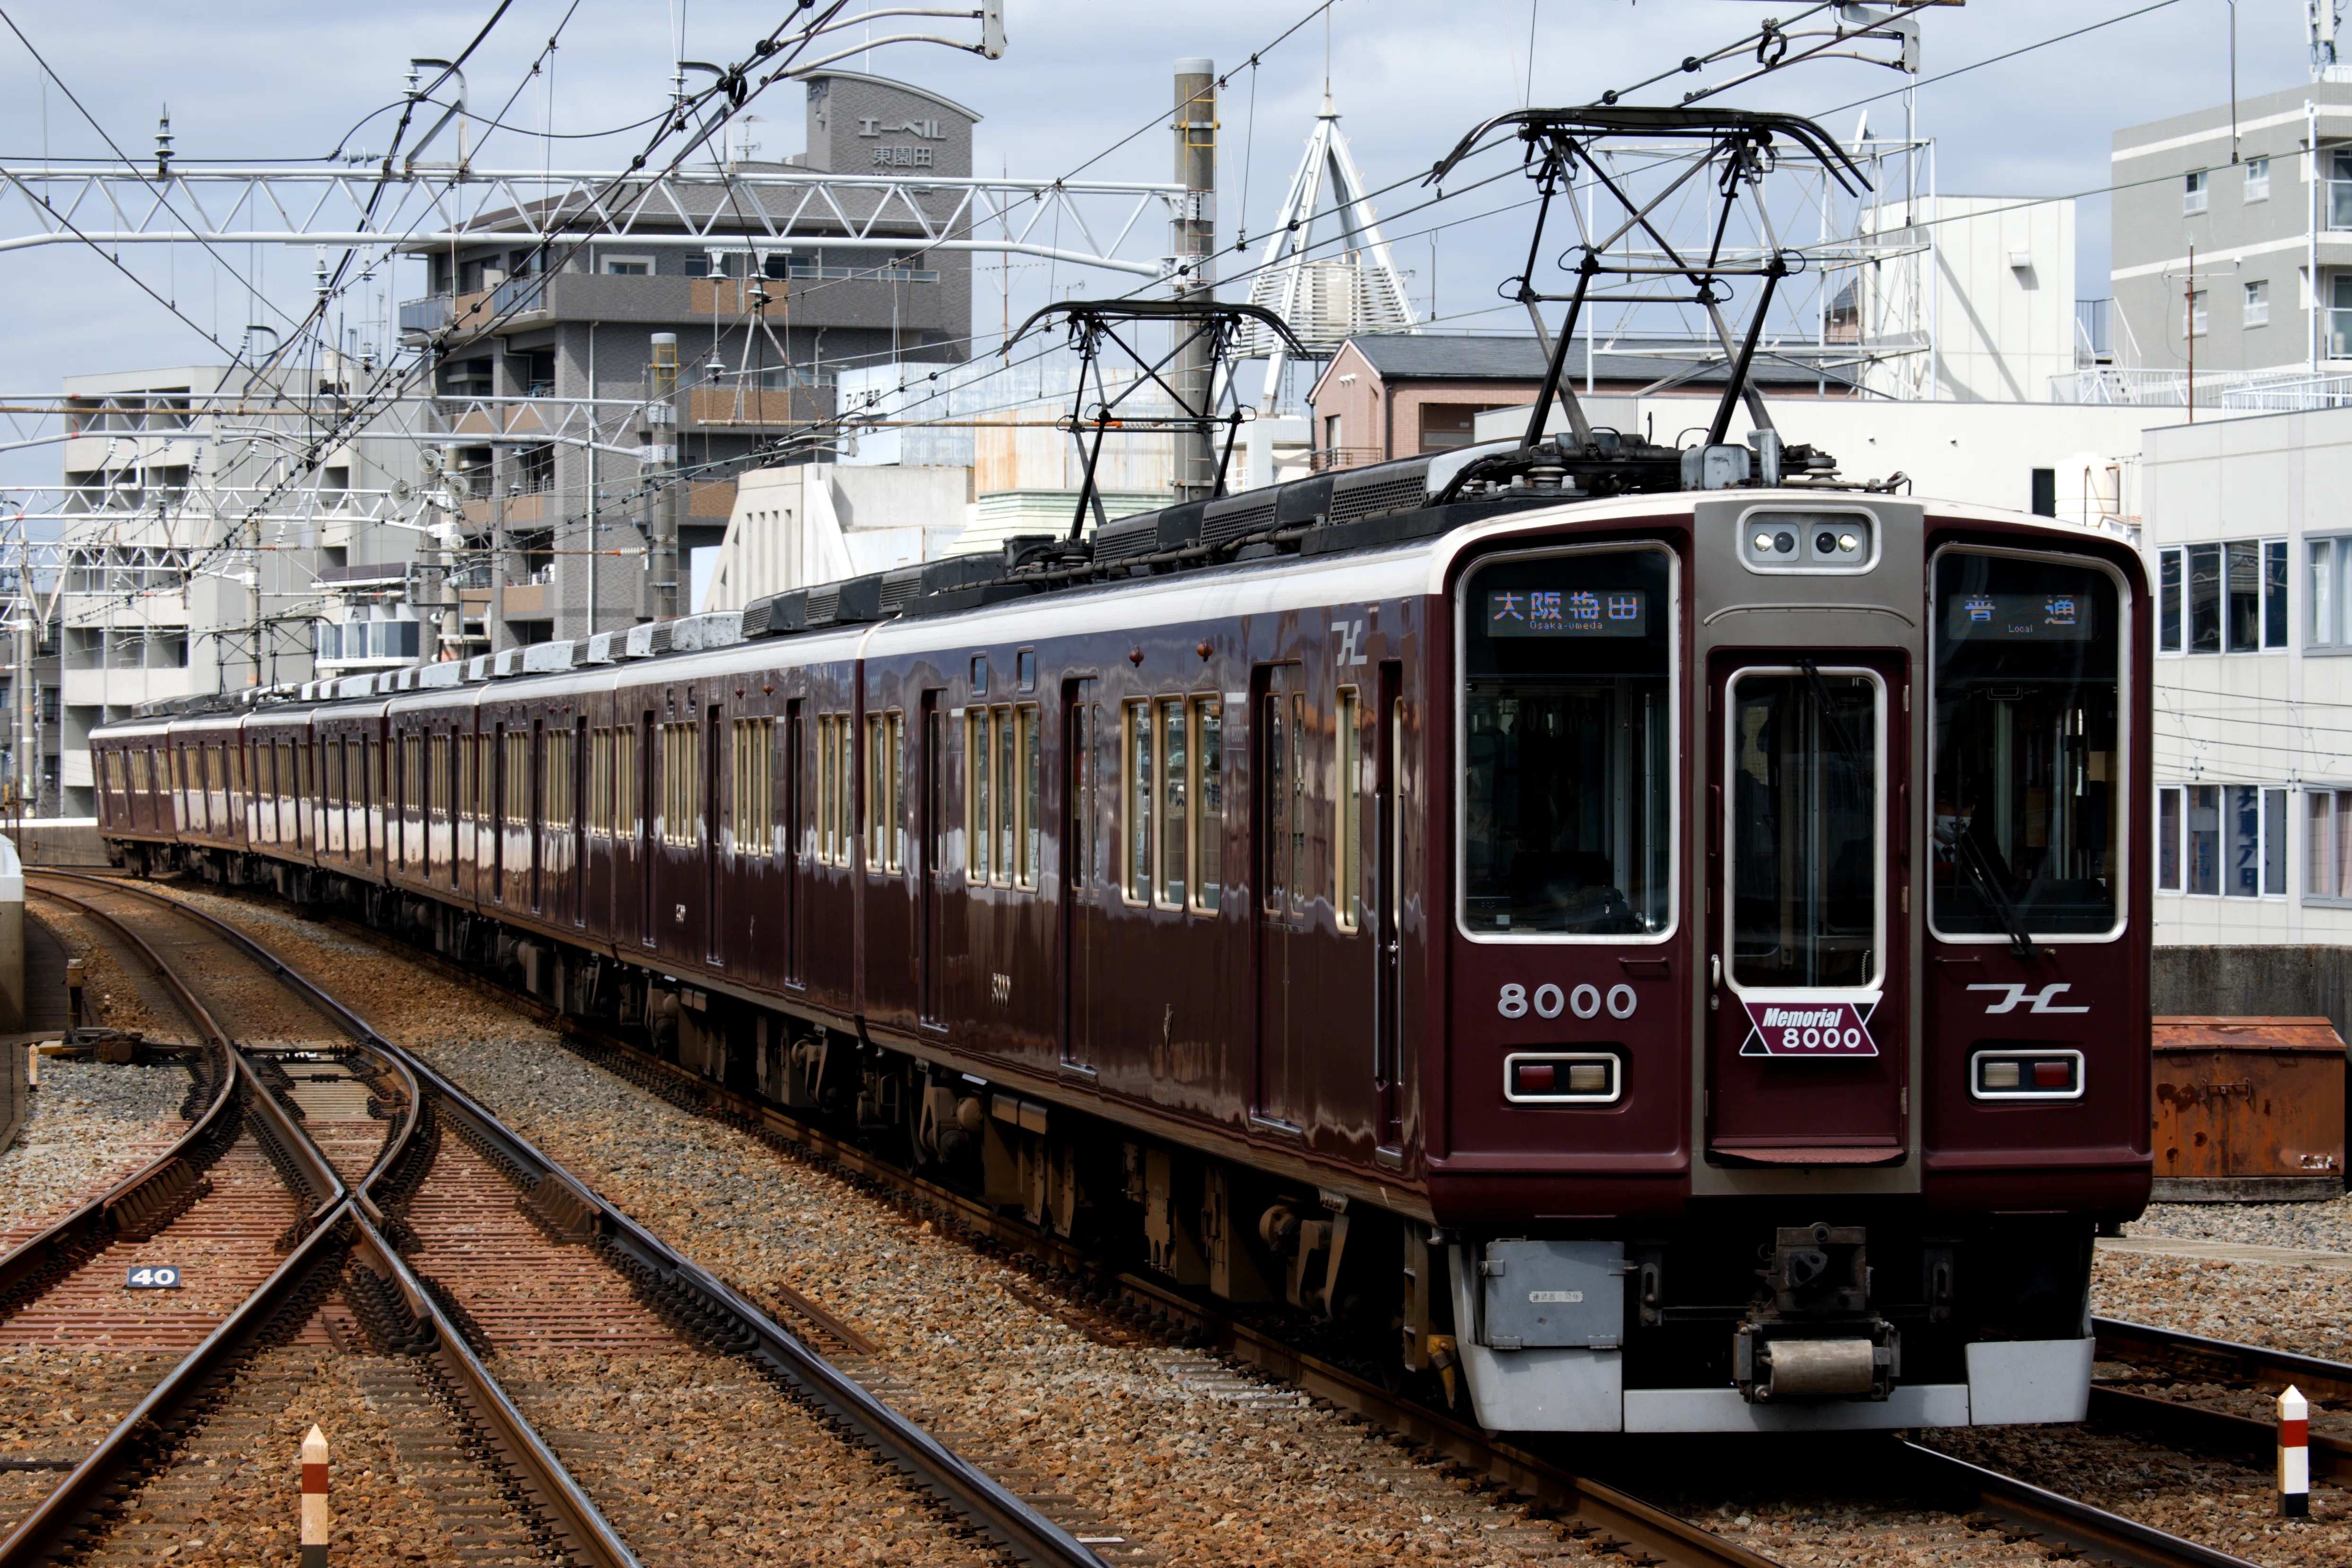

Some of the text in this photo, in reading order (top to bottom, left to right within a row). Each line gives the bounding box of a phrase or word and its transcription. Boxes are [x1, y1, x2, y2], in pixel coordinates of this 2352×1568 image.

[859, 118, 946, 139] エーベル
[873, 146, 932, 166] 東園田
[1493, 591, 1637, 621] 大阪梅田
[1964, 594, 2075, 624] 普通
[2008, 624, 2033, 633] Local
[992, 973, 1011, 1008] 8000
[1497, 983, 1638, 1019] 8000
[1762, 1008, 1843, 1027] Memorial
[1782, 1028, 1861, 1048] 8000
[131, 1269, 175, 1285] 40
